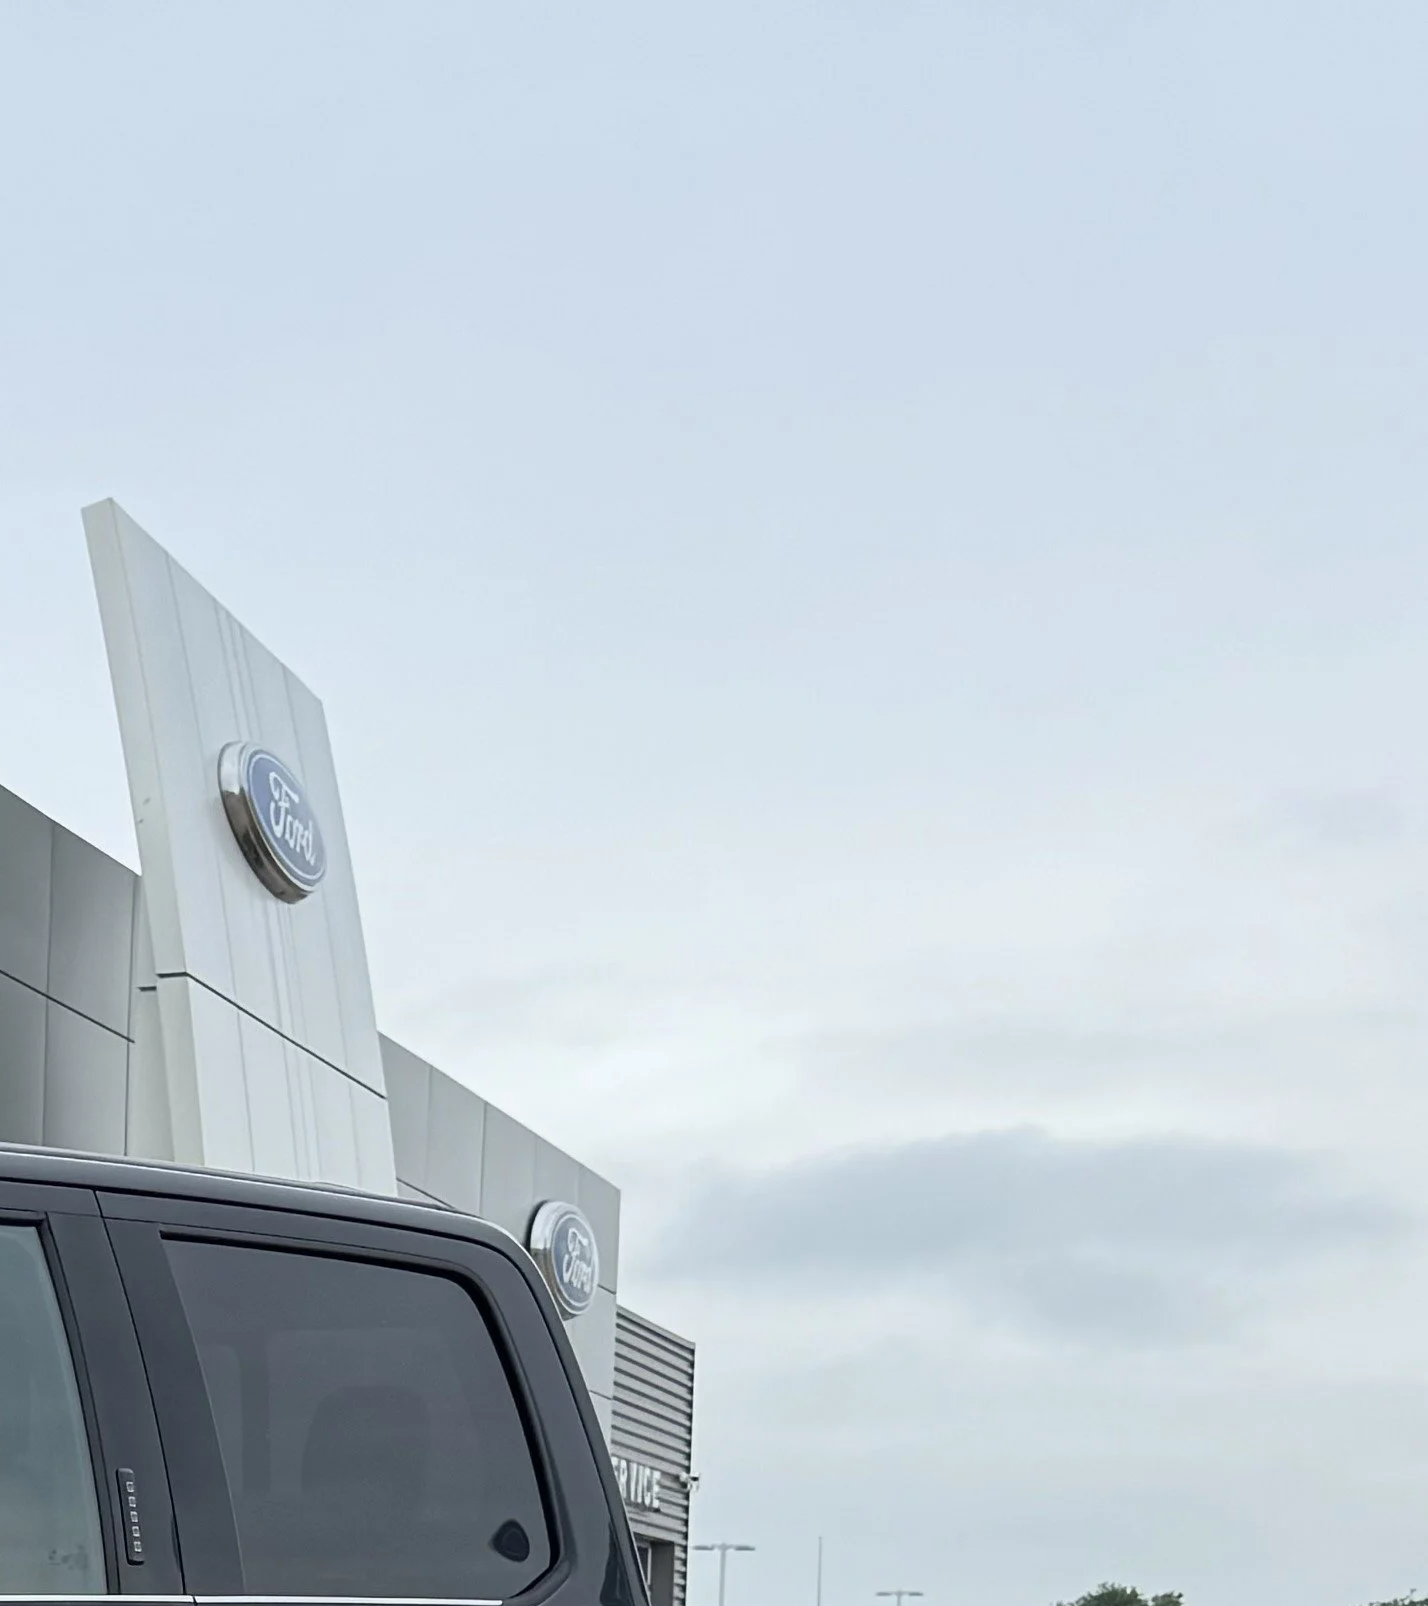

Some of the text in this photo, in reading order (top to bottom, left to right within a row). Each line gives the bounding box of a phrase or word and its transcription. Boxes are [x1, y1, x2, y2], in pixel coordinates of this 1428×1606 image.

[267, 770, 316, 867] Ford
[562, 1226, 593, 1294] Ford
[611, 1456, 661, 1508] RVICE
